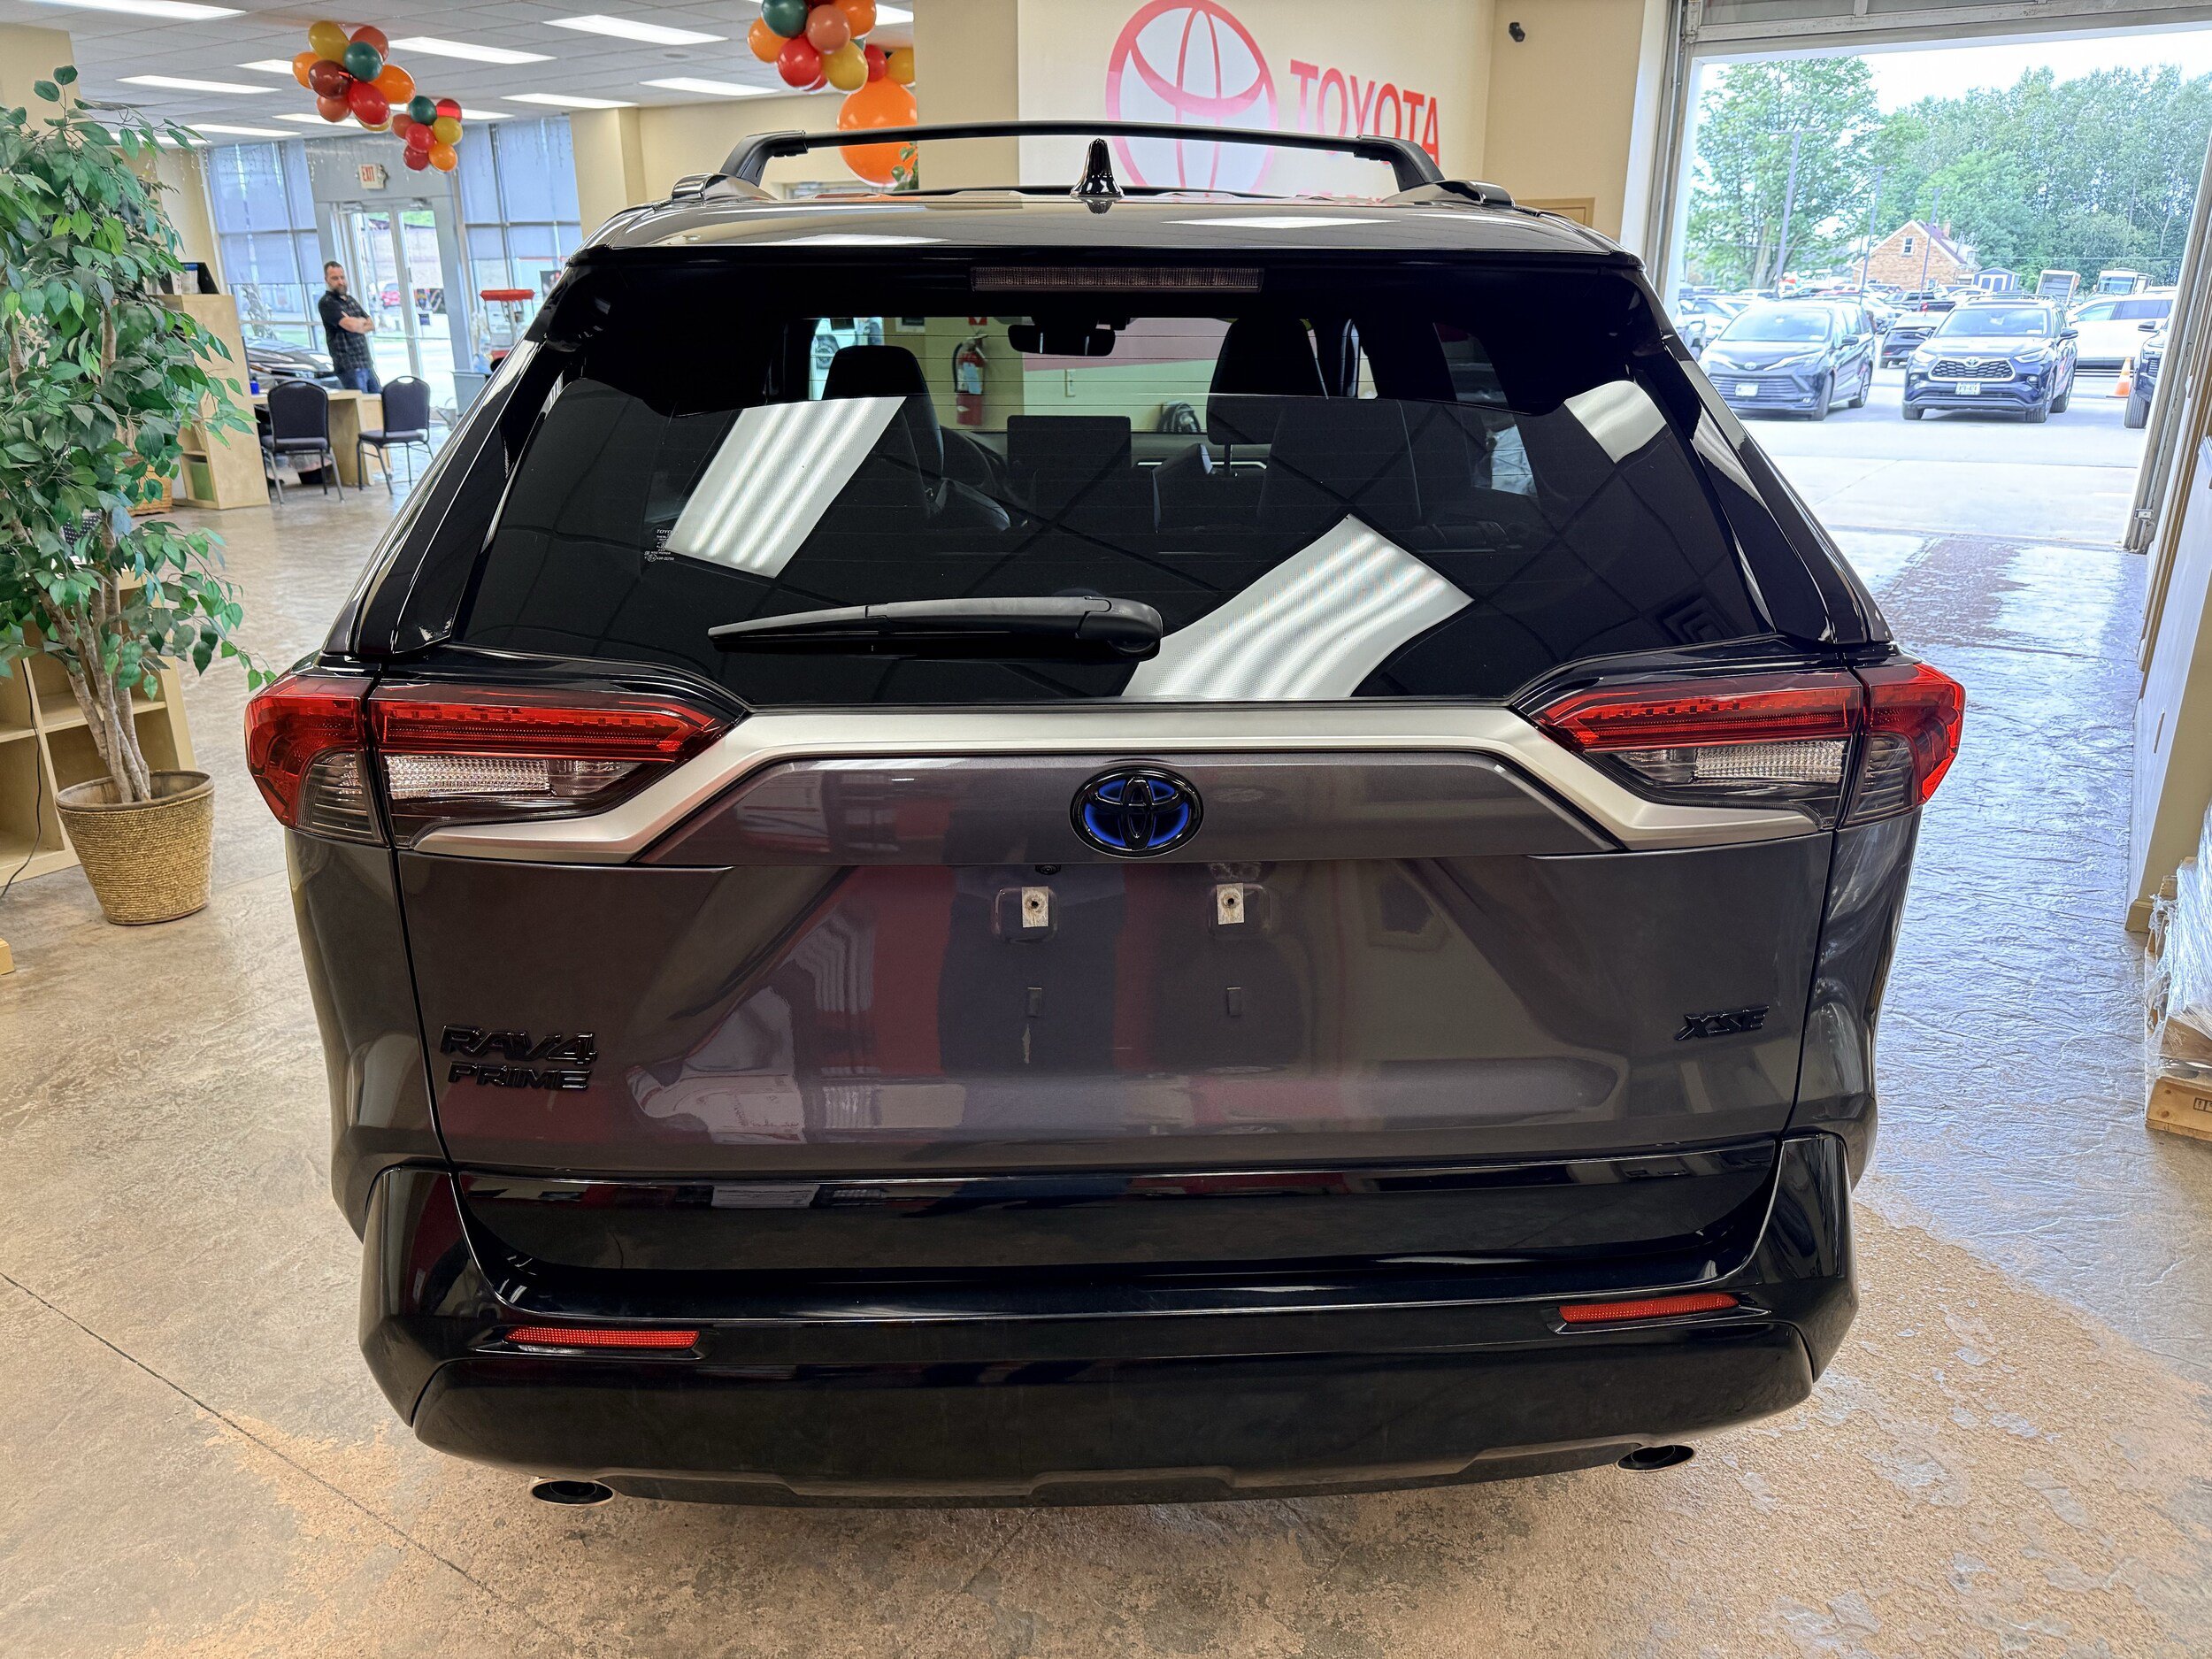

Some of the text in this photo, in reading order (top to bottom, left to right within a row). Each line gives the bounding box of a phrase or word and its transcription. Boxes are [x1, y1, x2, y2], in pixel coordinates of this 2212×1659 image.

[1290, 58, 1440, 168] TOYOTA
[361, 165, 375, 182] EXIT
[1673, 1005, 1770, 1041] XSE
[440, 1024, 598, 1066] RAV4
[448, 1062, 592, 1091] PRIME
